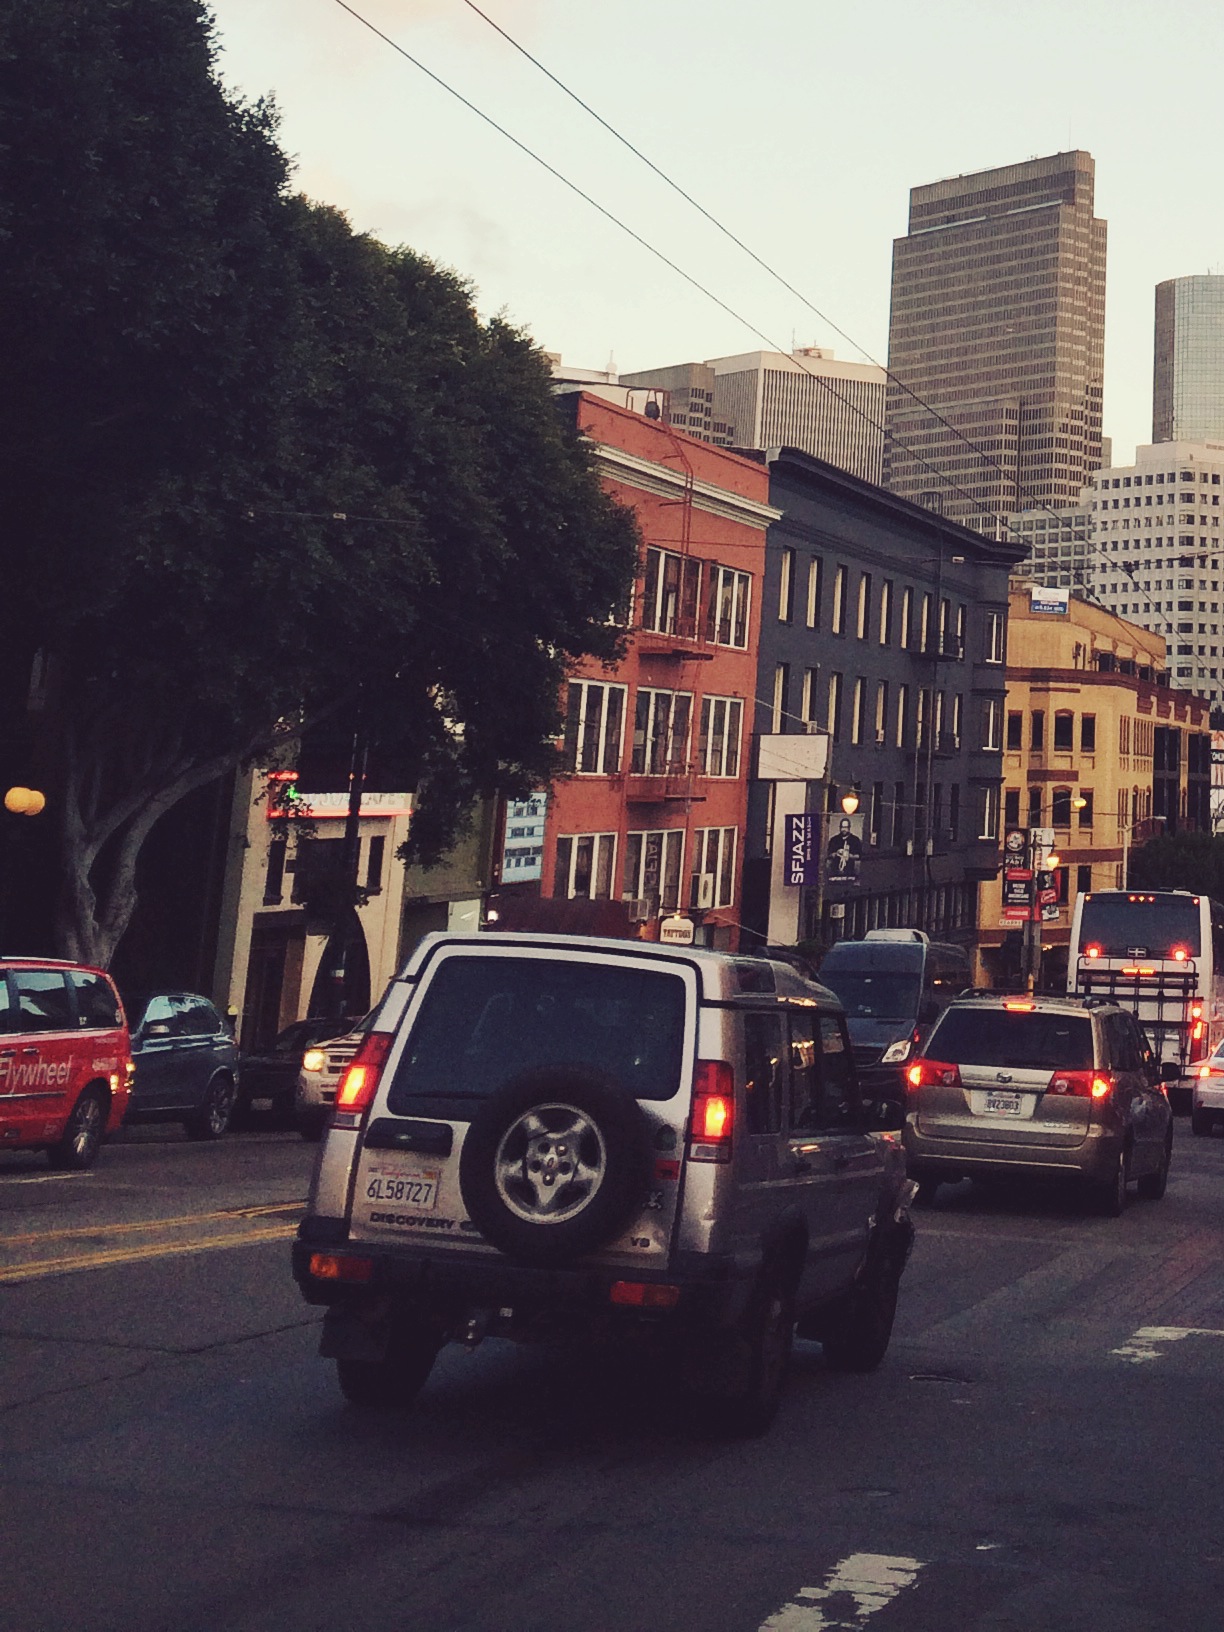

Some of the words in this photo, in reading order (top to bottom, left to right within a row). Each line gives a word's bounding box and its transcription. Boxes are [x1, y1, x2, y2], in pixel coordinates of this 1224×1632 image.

[790, 816, 806, 884] SFJAZZ
[366, 1179, 433, 1203] 6L58727
[369, 1211, 456, 1230] DISCOVERY
